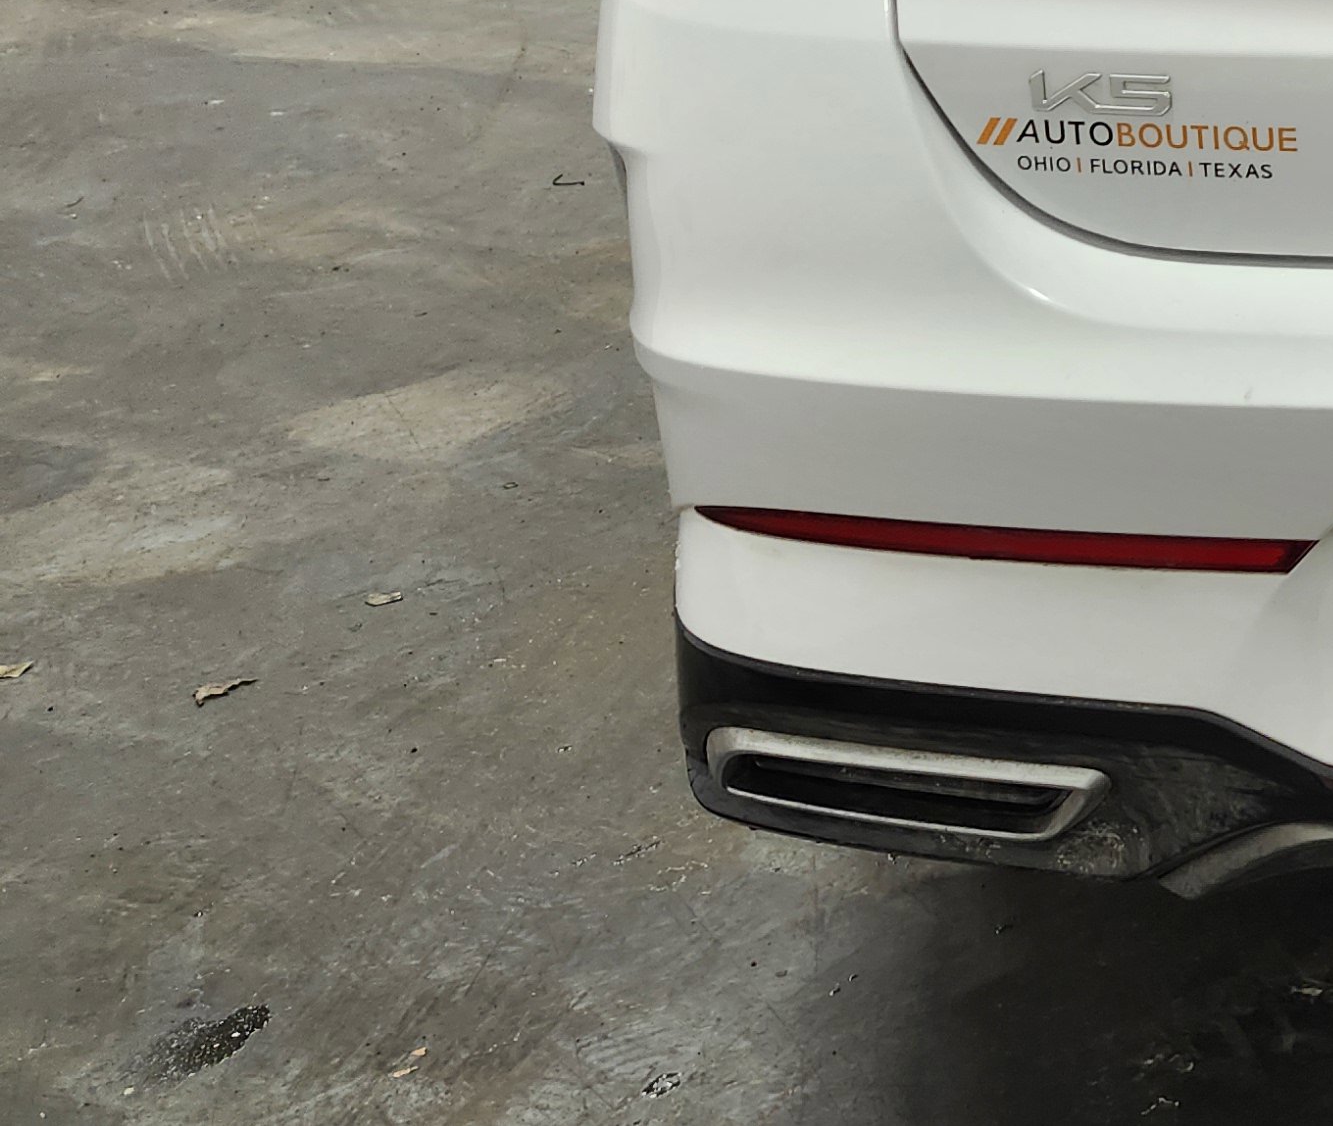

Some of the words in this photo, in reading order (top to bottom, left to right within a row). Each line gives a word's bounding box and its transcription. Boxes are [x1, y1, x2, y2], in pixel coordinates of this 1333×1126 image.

[1028, 68, 1173, 116] K5
[1017, 118, 1298, 152] AUTOBOUTIQUE
[1017, 155, 1071, 173] OHIO
[1089, 158, 1182, 177] FLORIDA
[1200, 162, 1273, 180] TEXAS
